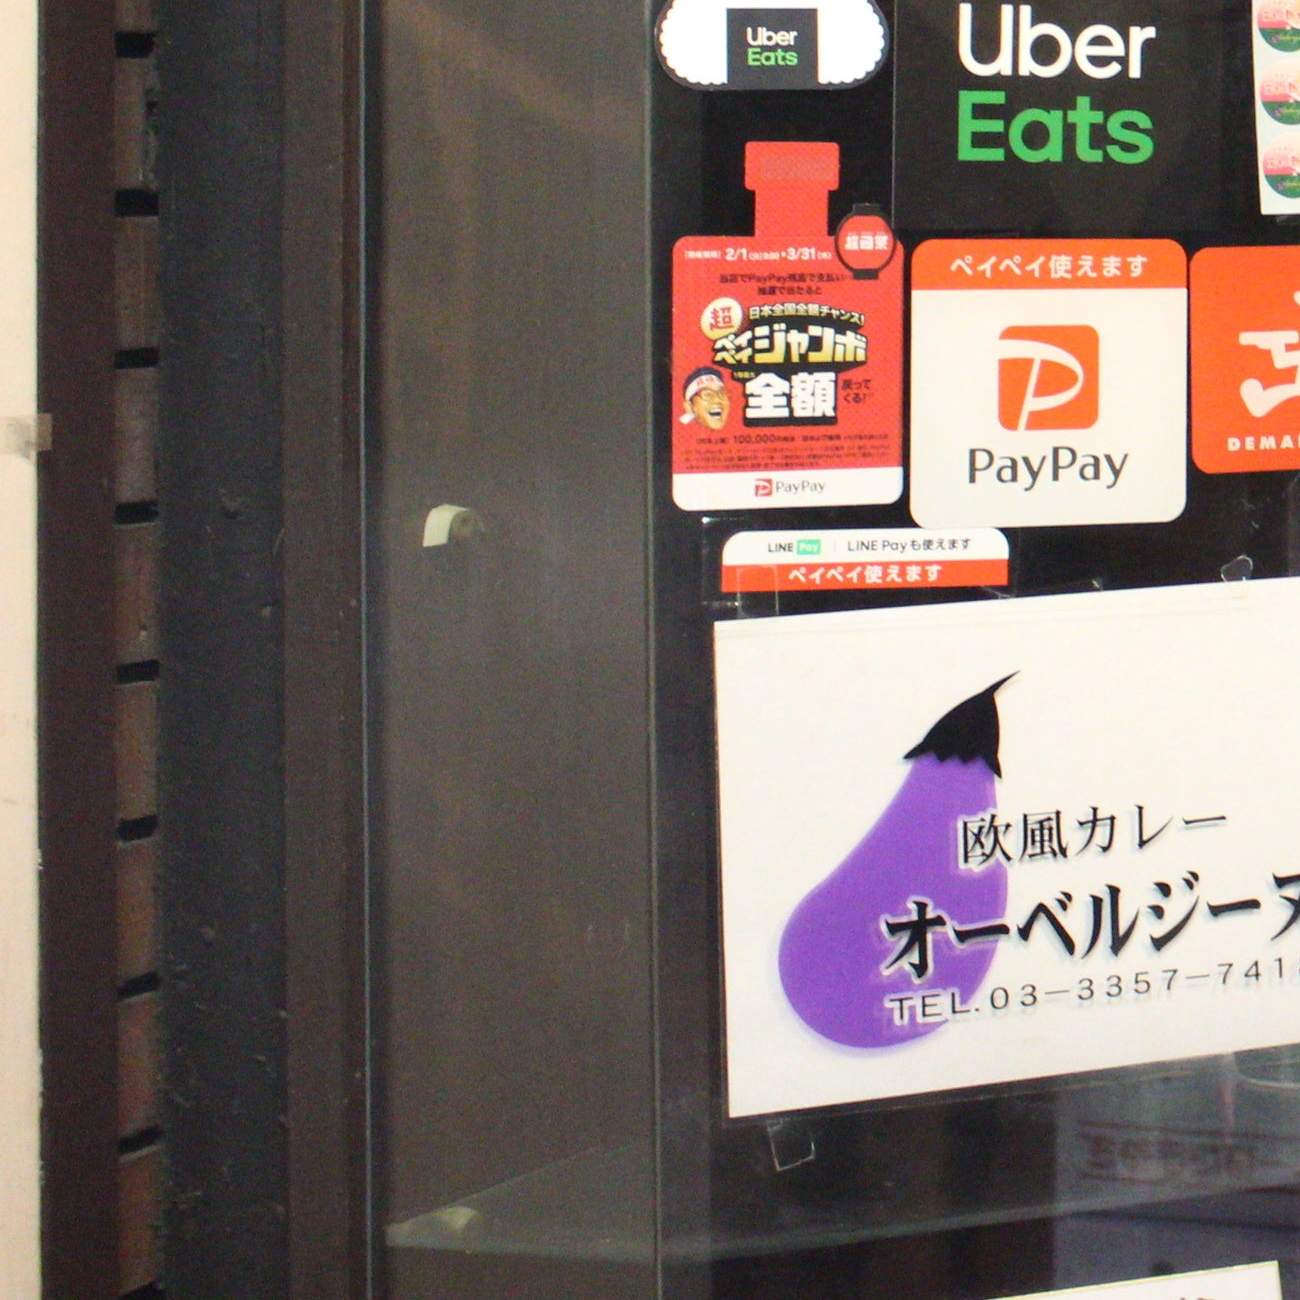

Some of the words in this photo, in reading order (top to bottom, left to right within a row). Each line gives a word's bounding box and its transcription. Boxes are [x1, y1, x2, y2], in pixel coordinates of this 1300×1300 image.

[746, 26, 798, 46] Uber
[958, 2, 1157, 79] Uber
[747, 47, 799, 66] Eats
[957, 89, 1155, 165] Eats
[950, 254, 1148, 279] ペイペイ使えます
[745, 371, 837, 419] 全額
[968, 446, 1129, 492] PayPay
[775, 480, 826, 497] PayPay
[768, 542, 794, 553] LINE
[788, 564, 943, 584] ペイペイ使えます
[961, 804, 1228, 867] 欧風カレー
